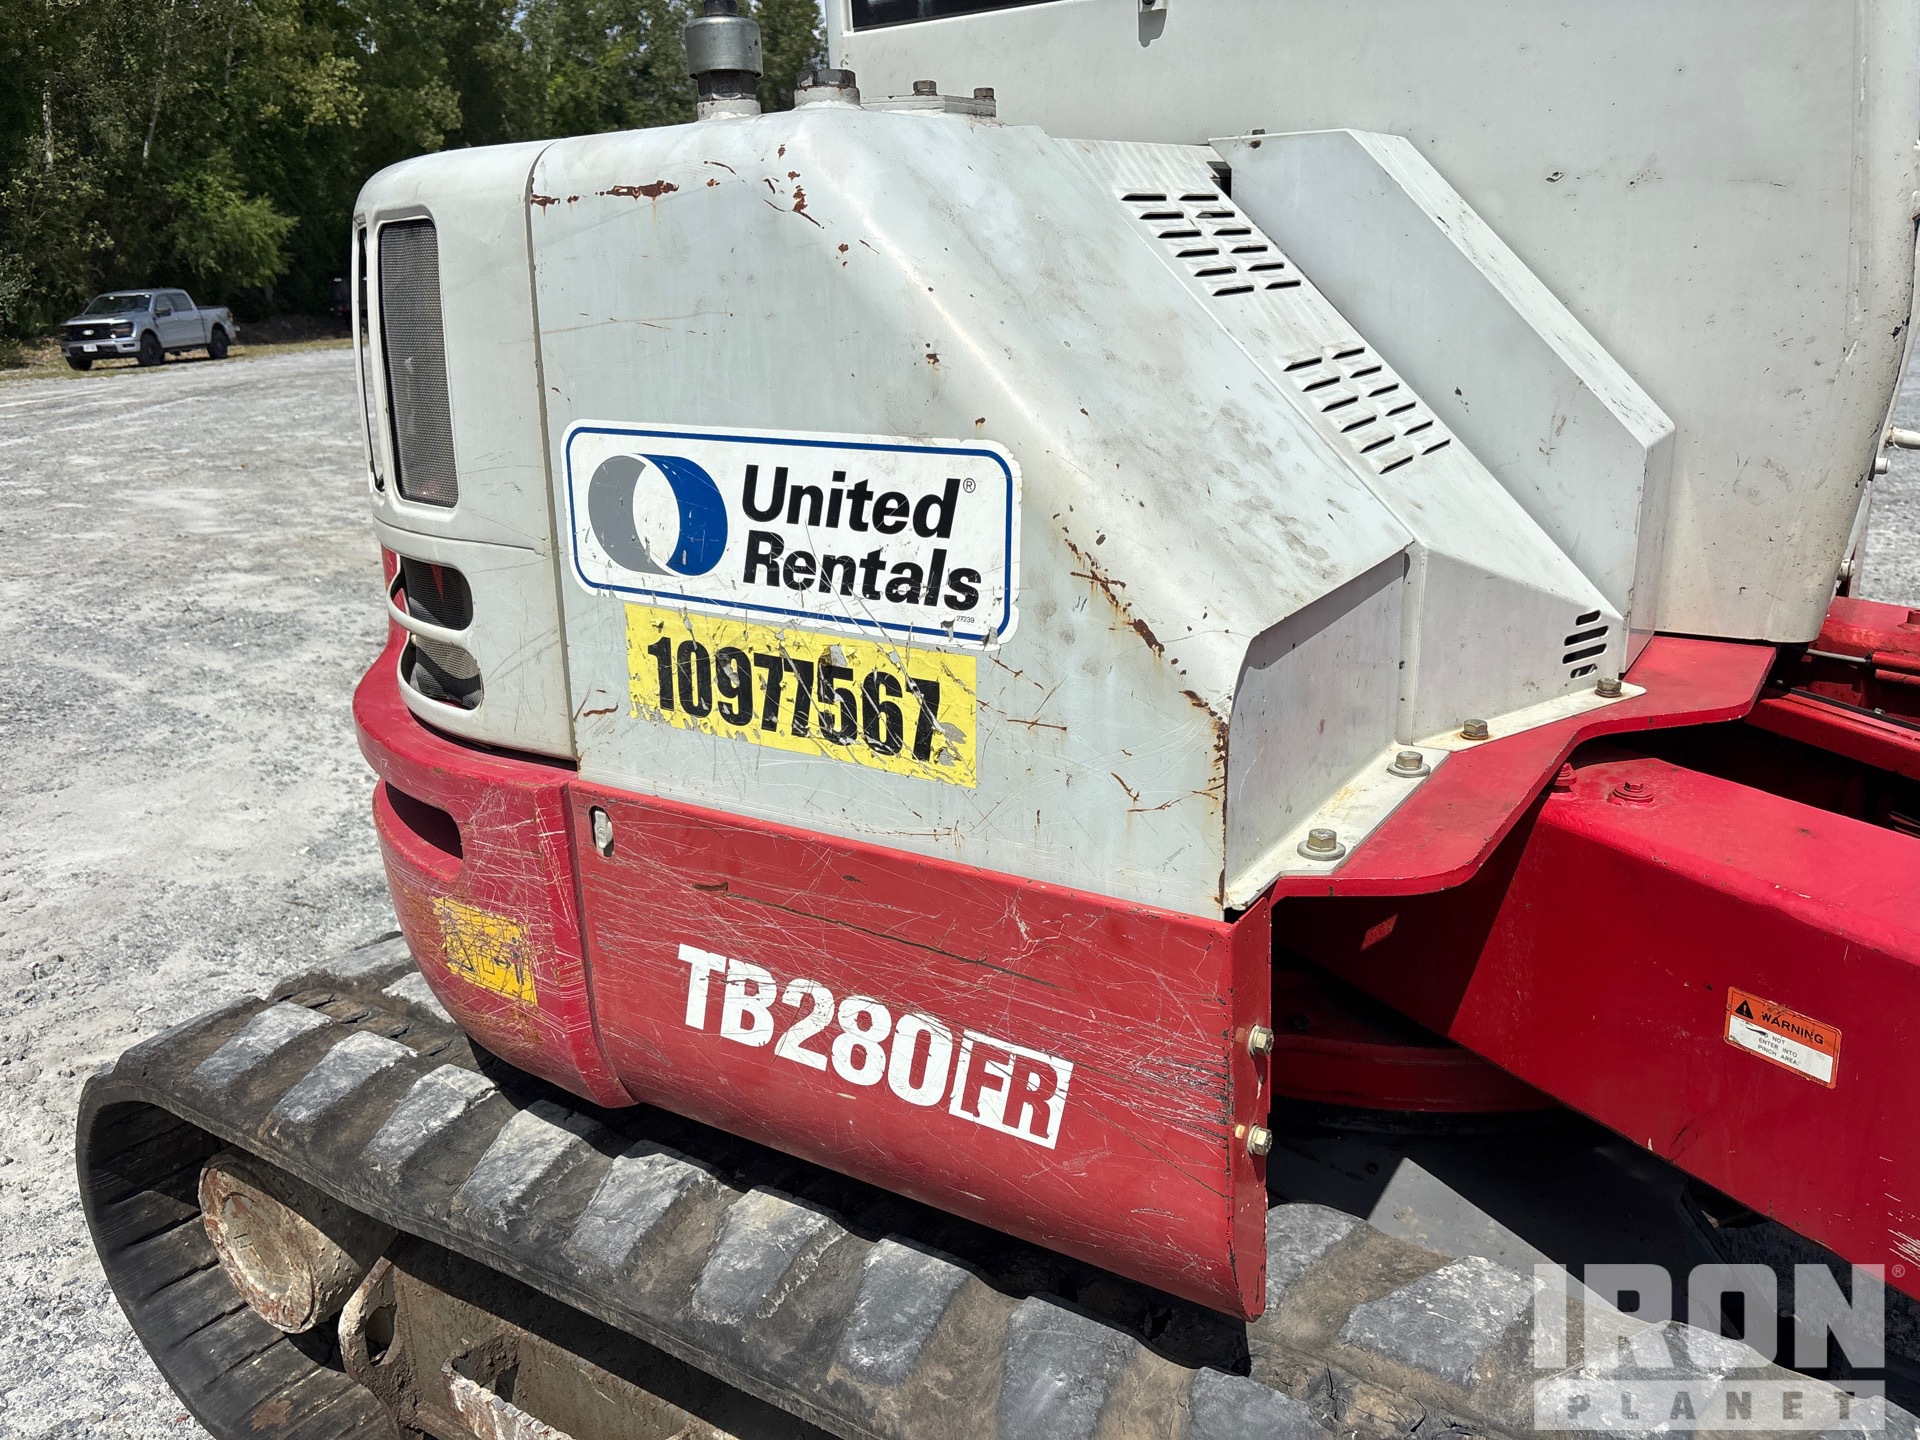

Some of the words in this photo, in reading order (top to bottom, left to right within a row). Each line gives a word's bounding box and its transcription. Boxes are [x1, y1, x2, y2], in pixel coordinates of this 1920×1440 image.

[741, 464, 962, 539] United
[743, 530, 982, 611] Rentals
[648, 637, 941, 762] 10977567
[1761, 1012, 1825, 1045] WARNING
[1772, 1035, 1786, 1045] NOT
[1757, 1044, 1777, 1057] PINCH
[1758, 1037, 1779, 1050] ENTER
[1782, 1047, 1798, 1058] INTO
